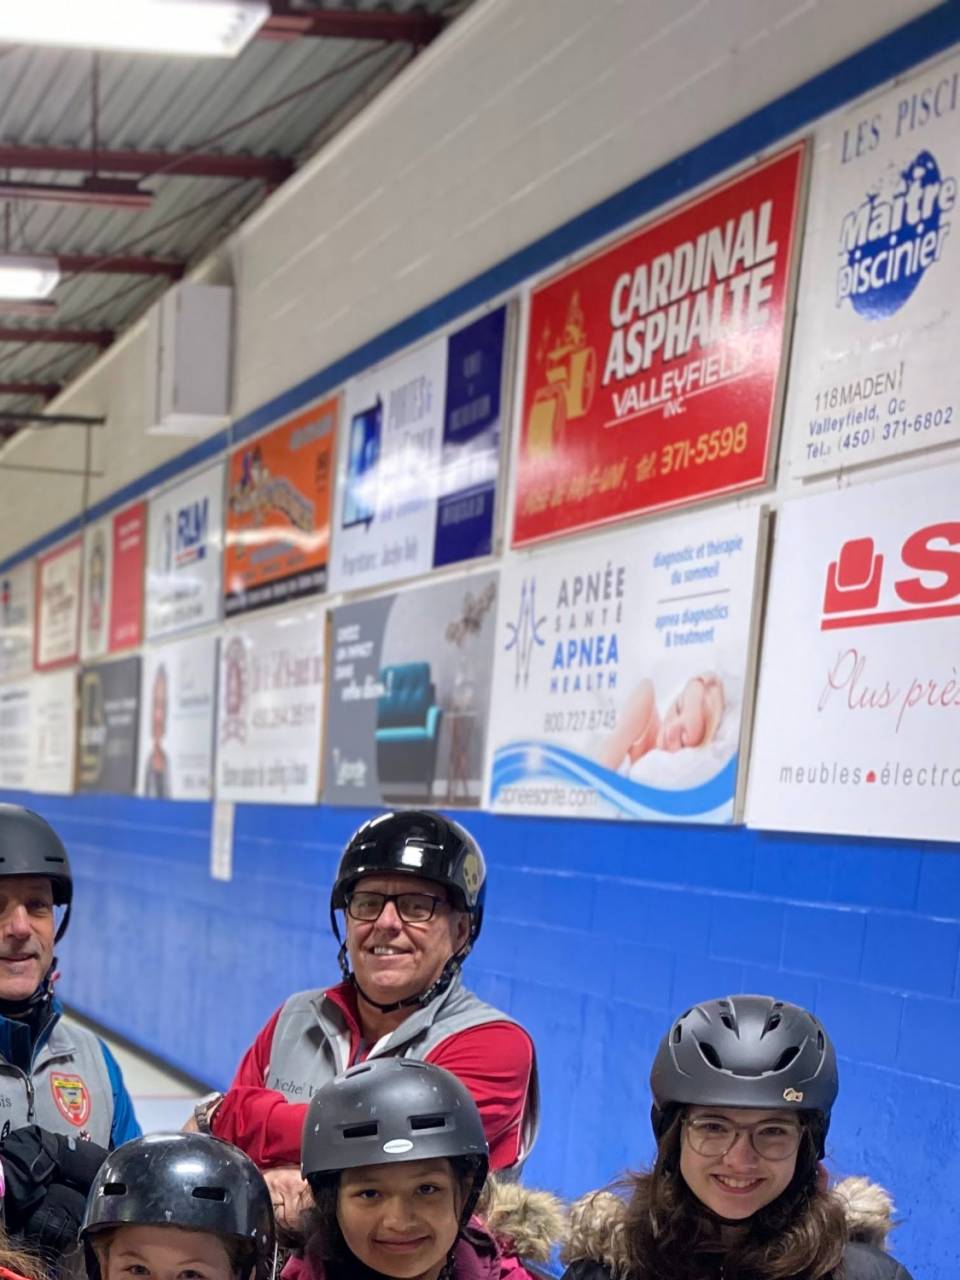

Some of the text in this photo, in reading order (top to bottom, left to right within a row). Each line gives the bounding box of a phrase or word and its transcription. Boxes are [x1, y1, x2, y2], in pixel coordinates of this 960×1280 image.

[841, 114, 882, 165] LES
[610, 201, 778, 329] CARDINAL
[836, 222, 951, 308] piscinier
[602, 260, 776, 387] ASPHALTE
[809, 398, 906, 437] Valleyfield, Qc
[839, 426, 876, 453] (450)
[882, 406, 953, 441] 371-6802
[660, 421, 748, 476] 371-5598
[556, 561, 626, 609] APNÉE
[554, 602, 623, 633] SANTÉ
[551, 633, 620, 671] APNEA
[550, 670, 617, 694] HEALTH
[817, 648, 891, 712] Plus
[779, 761, 862, 785] meubles
